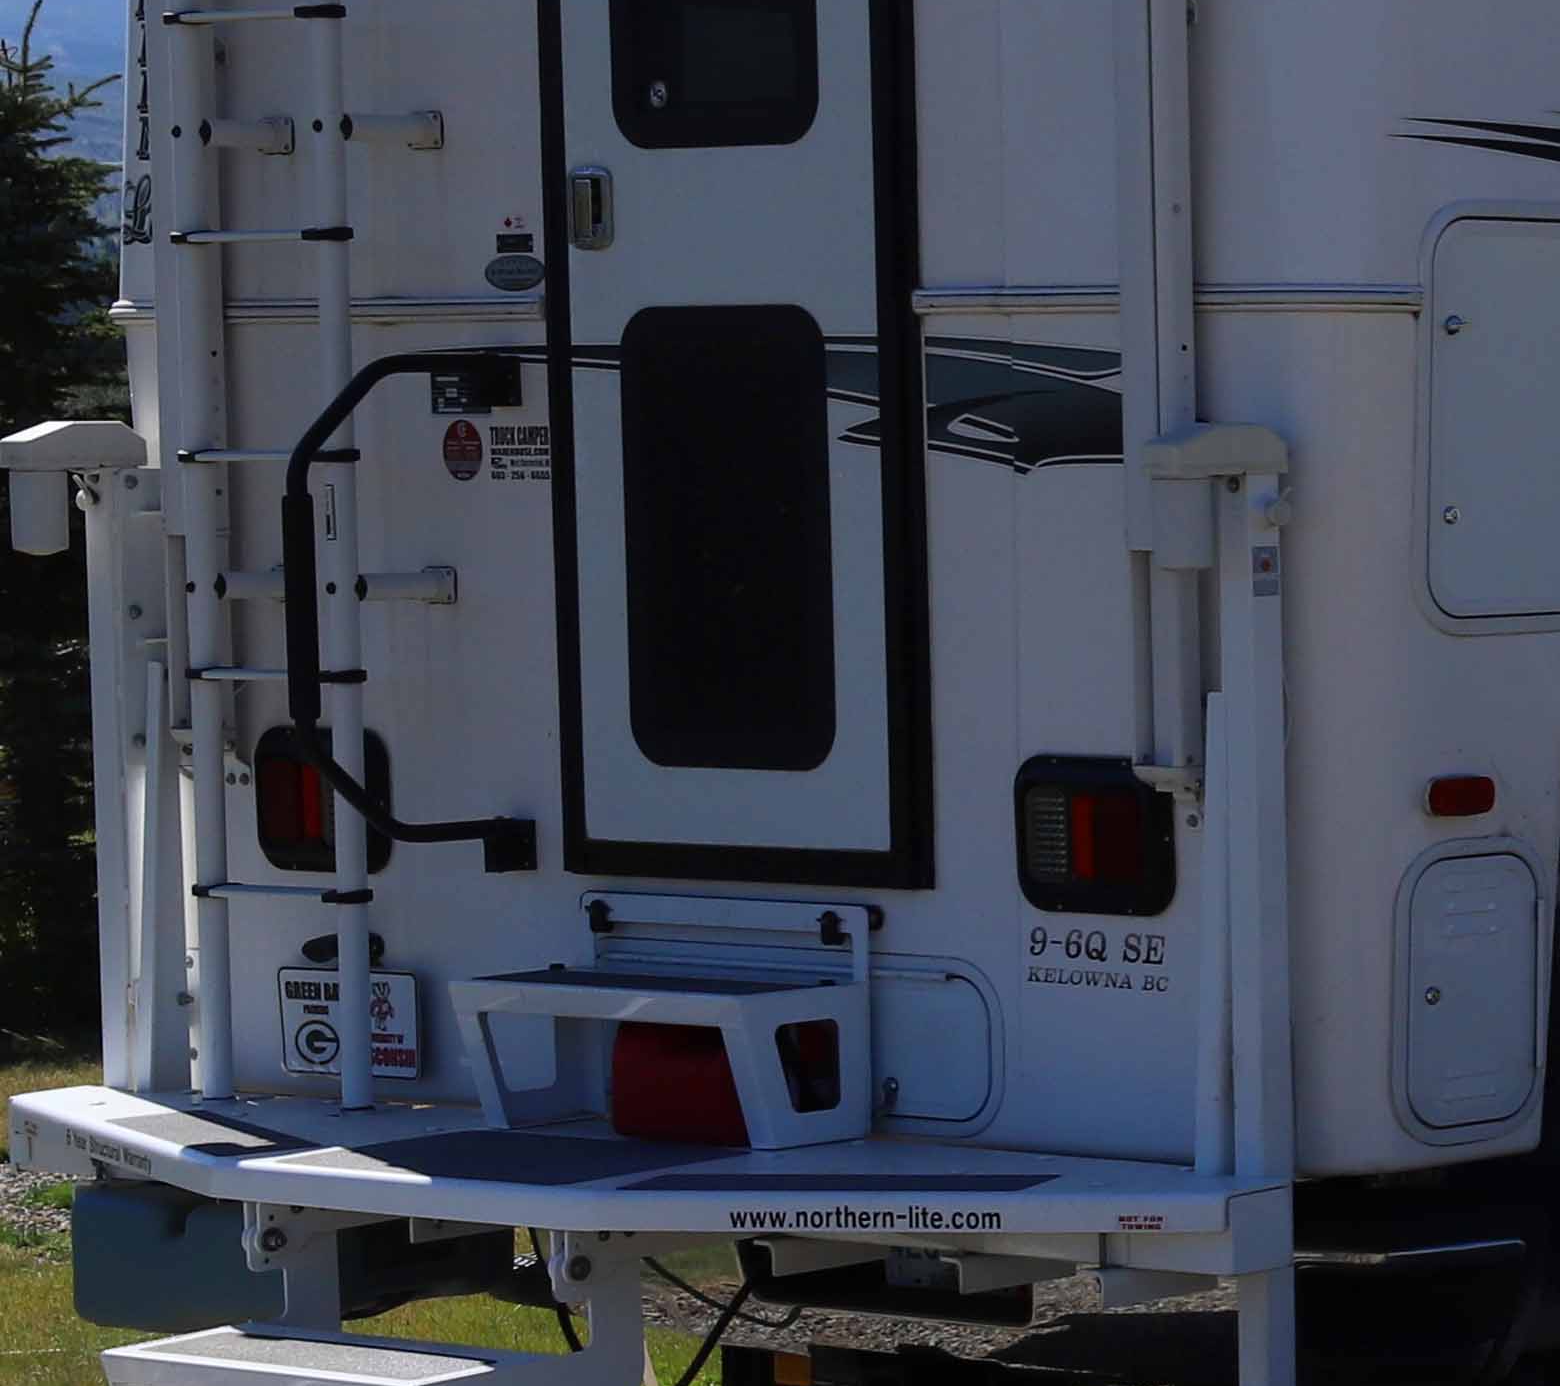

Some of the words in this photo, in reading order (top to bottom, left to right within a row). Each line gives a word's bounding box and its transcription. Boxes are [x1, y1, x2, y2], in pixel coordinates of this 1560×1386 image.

[1029, 925, 1109, 963] 9-6Q
[1122, 932, 1166, 966] SE
[285, 980, 321, 1001] GREEN
[1027, 966, 1133, 990] KELOWNA
[1141, 975, 1170, 992] BC
[729, 1205, 1003, 1231] www.northern-lite.com
